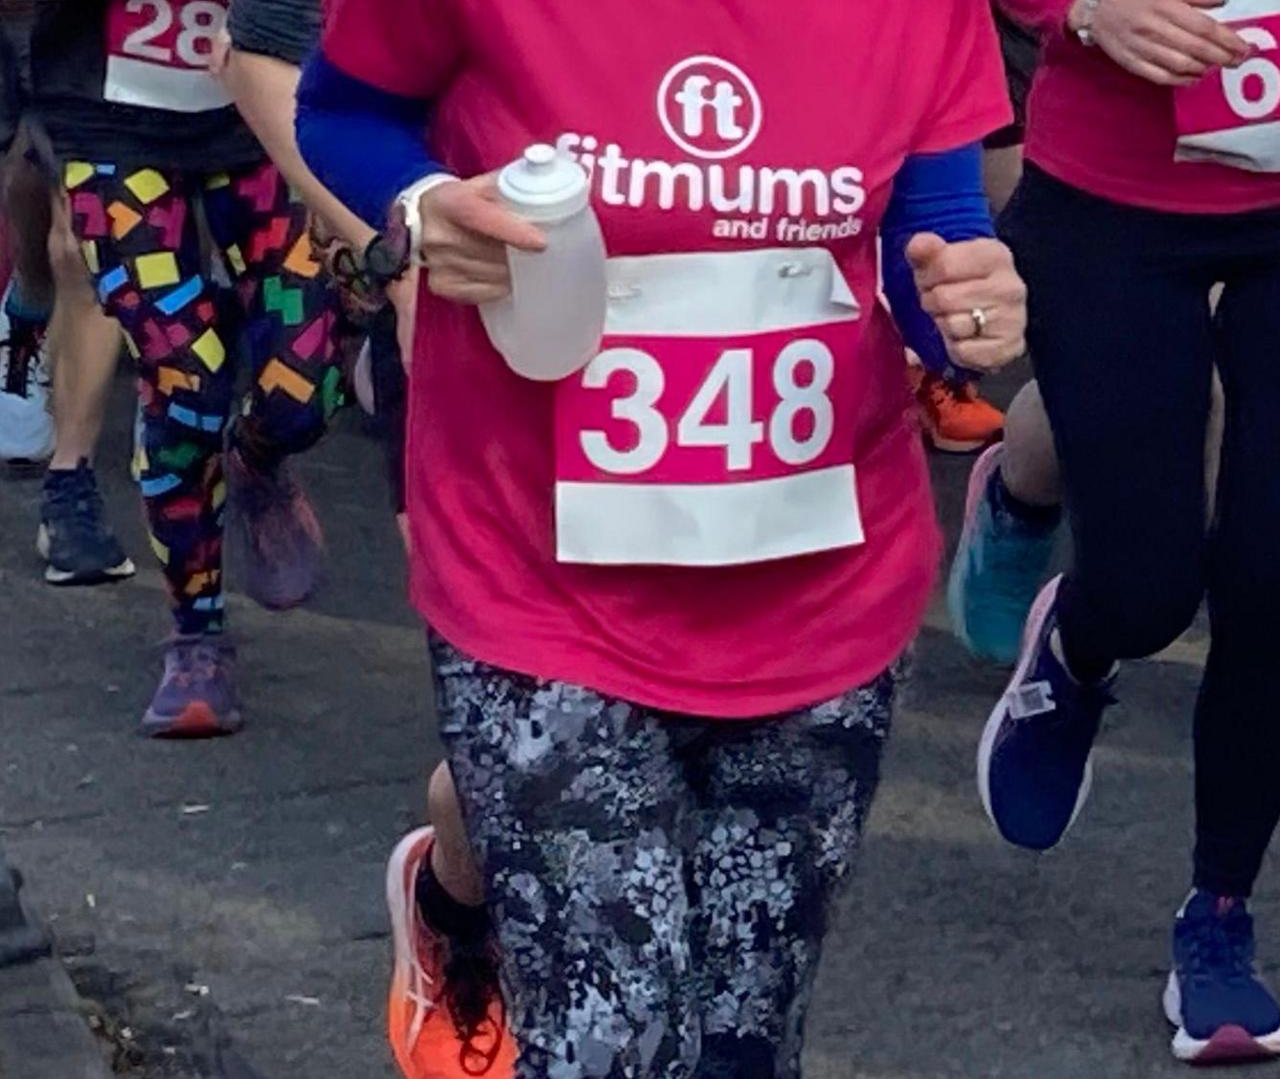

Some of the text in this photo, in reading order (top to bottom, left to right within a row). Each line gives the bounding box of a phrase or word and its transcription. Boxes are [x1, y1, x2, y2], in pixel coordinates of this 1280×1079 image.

[675, 75, 742, 139] ft
[713, 217, 862, 241] and friends
[579, 338, 835, 474] 348
